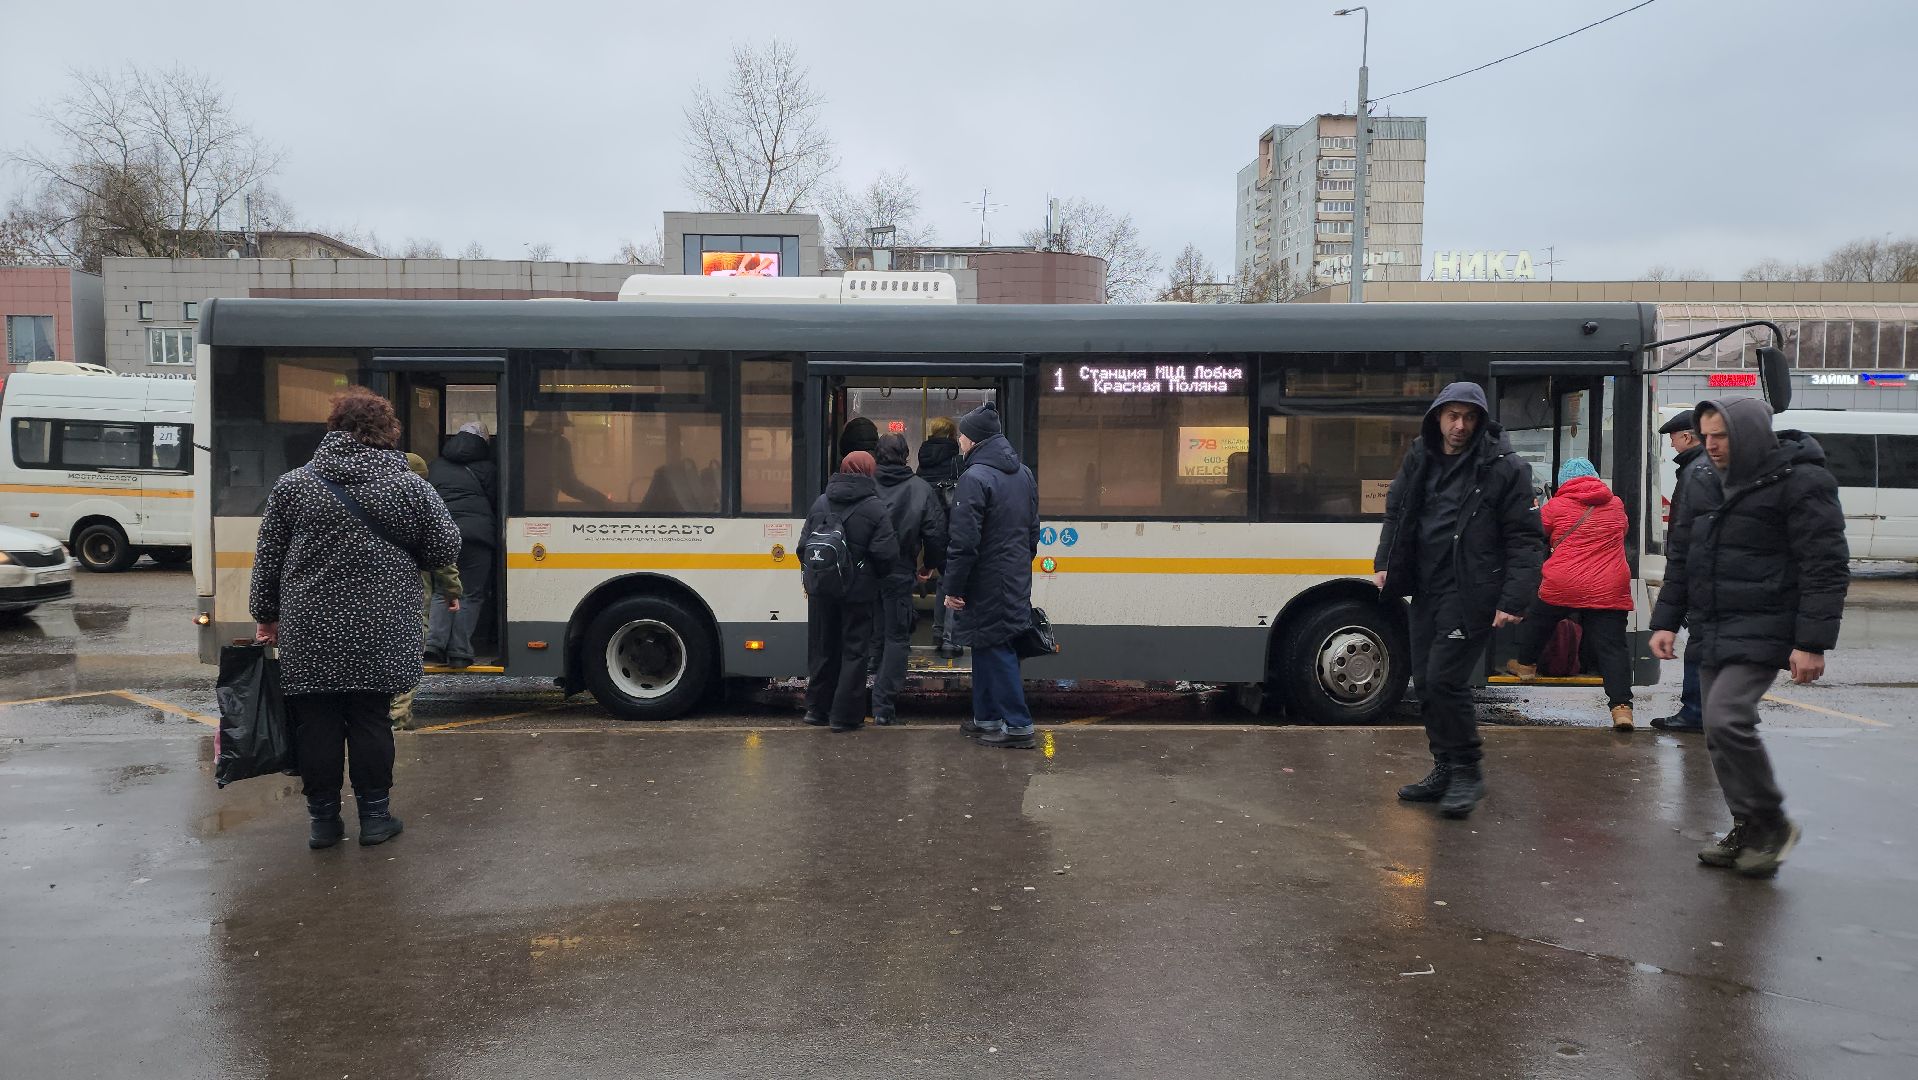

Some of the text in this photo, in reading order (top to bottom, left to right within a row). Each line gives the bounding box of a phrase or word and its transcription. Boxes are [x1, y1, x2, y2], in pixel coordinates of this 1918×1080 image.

[1433, 251, 1535, 280] НИКА
[1054, 368, 1064, 391] 1
[1079, 366, 1242, 381] Станция МЦД Лобня
[1812, 374, 1859, 385] ЗАЙМЫ
[1094, 380, 1228, 393] Красная Поляна
[68, 473, 137, 482] МОСТРАНСАВТО
[572, 524, 715, 535] МОСТРАНСАВТО
